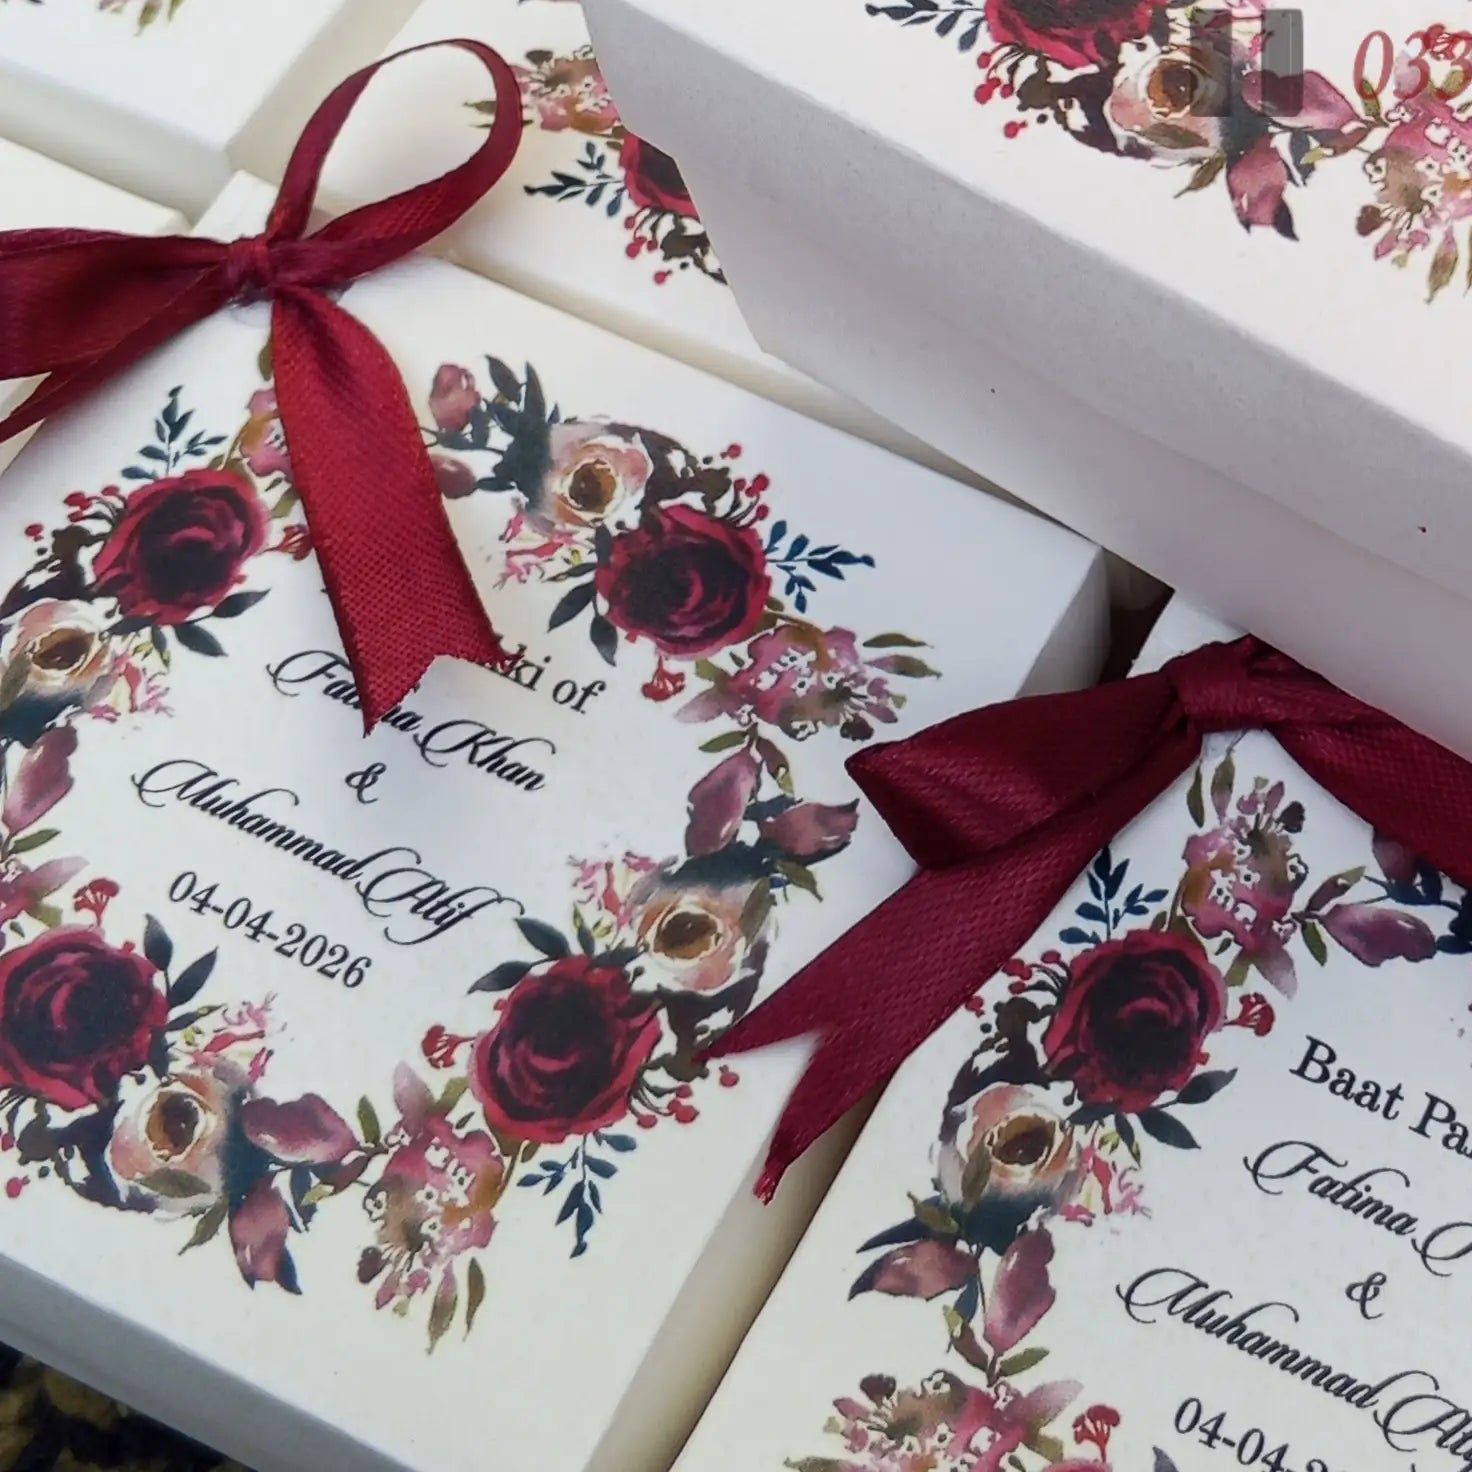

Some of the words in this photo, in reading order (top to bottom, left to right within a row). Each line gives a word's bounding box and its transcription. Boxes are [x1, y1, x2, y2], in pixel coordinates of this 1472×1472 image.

[552, 679, 607, 715] of
[345, 762, 387, 804] &
[413, 719, 557, 792] Khan
[131, 759, 421, 882] Muhammad
[168, 871, 373, 989] 04-04-2026
[1289, 1034, 1405, 1120] Baat
[1243, 1140, 1418, 1237] Fatima
[1345, 1270, 1387, 1320] &
[1116, 1268, 1440, 1410] Muhammad
